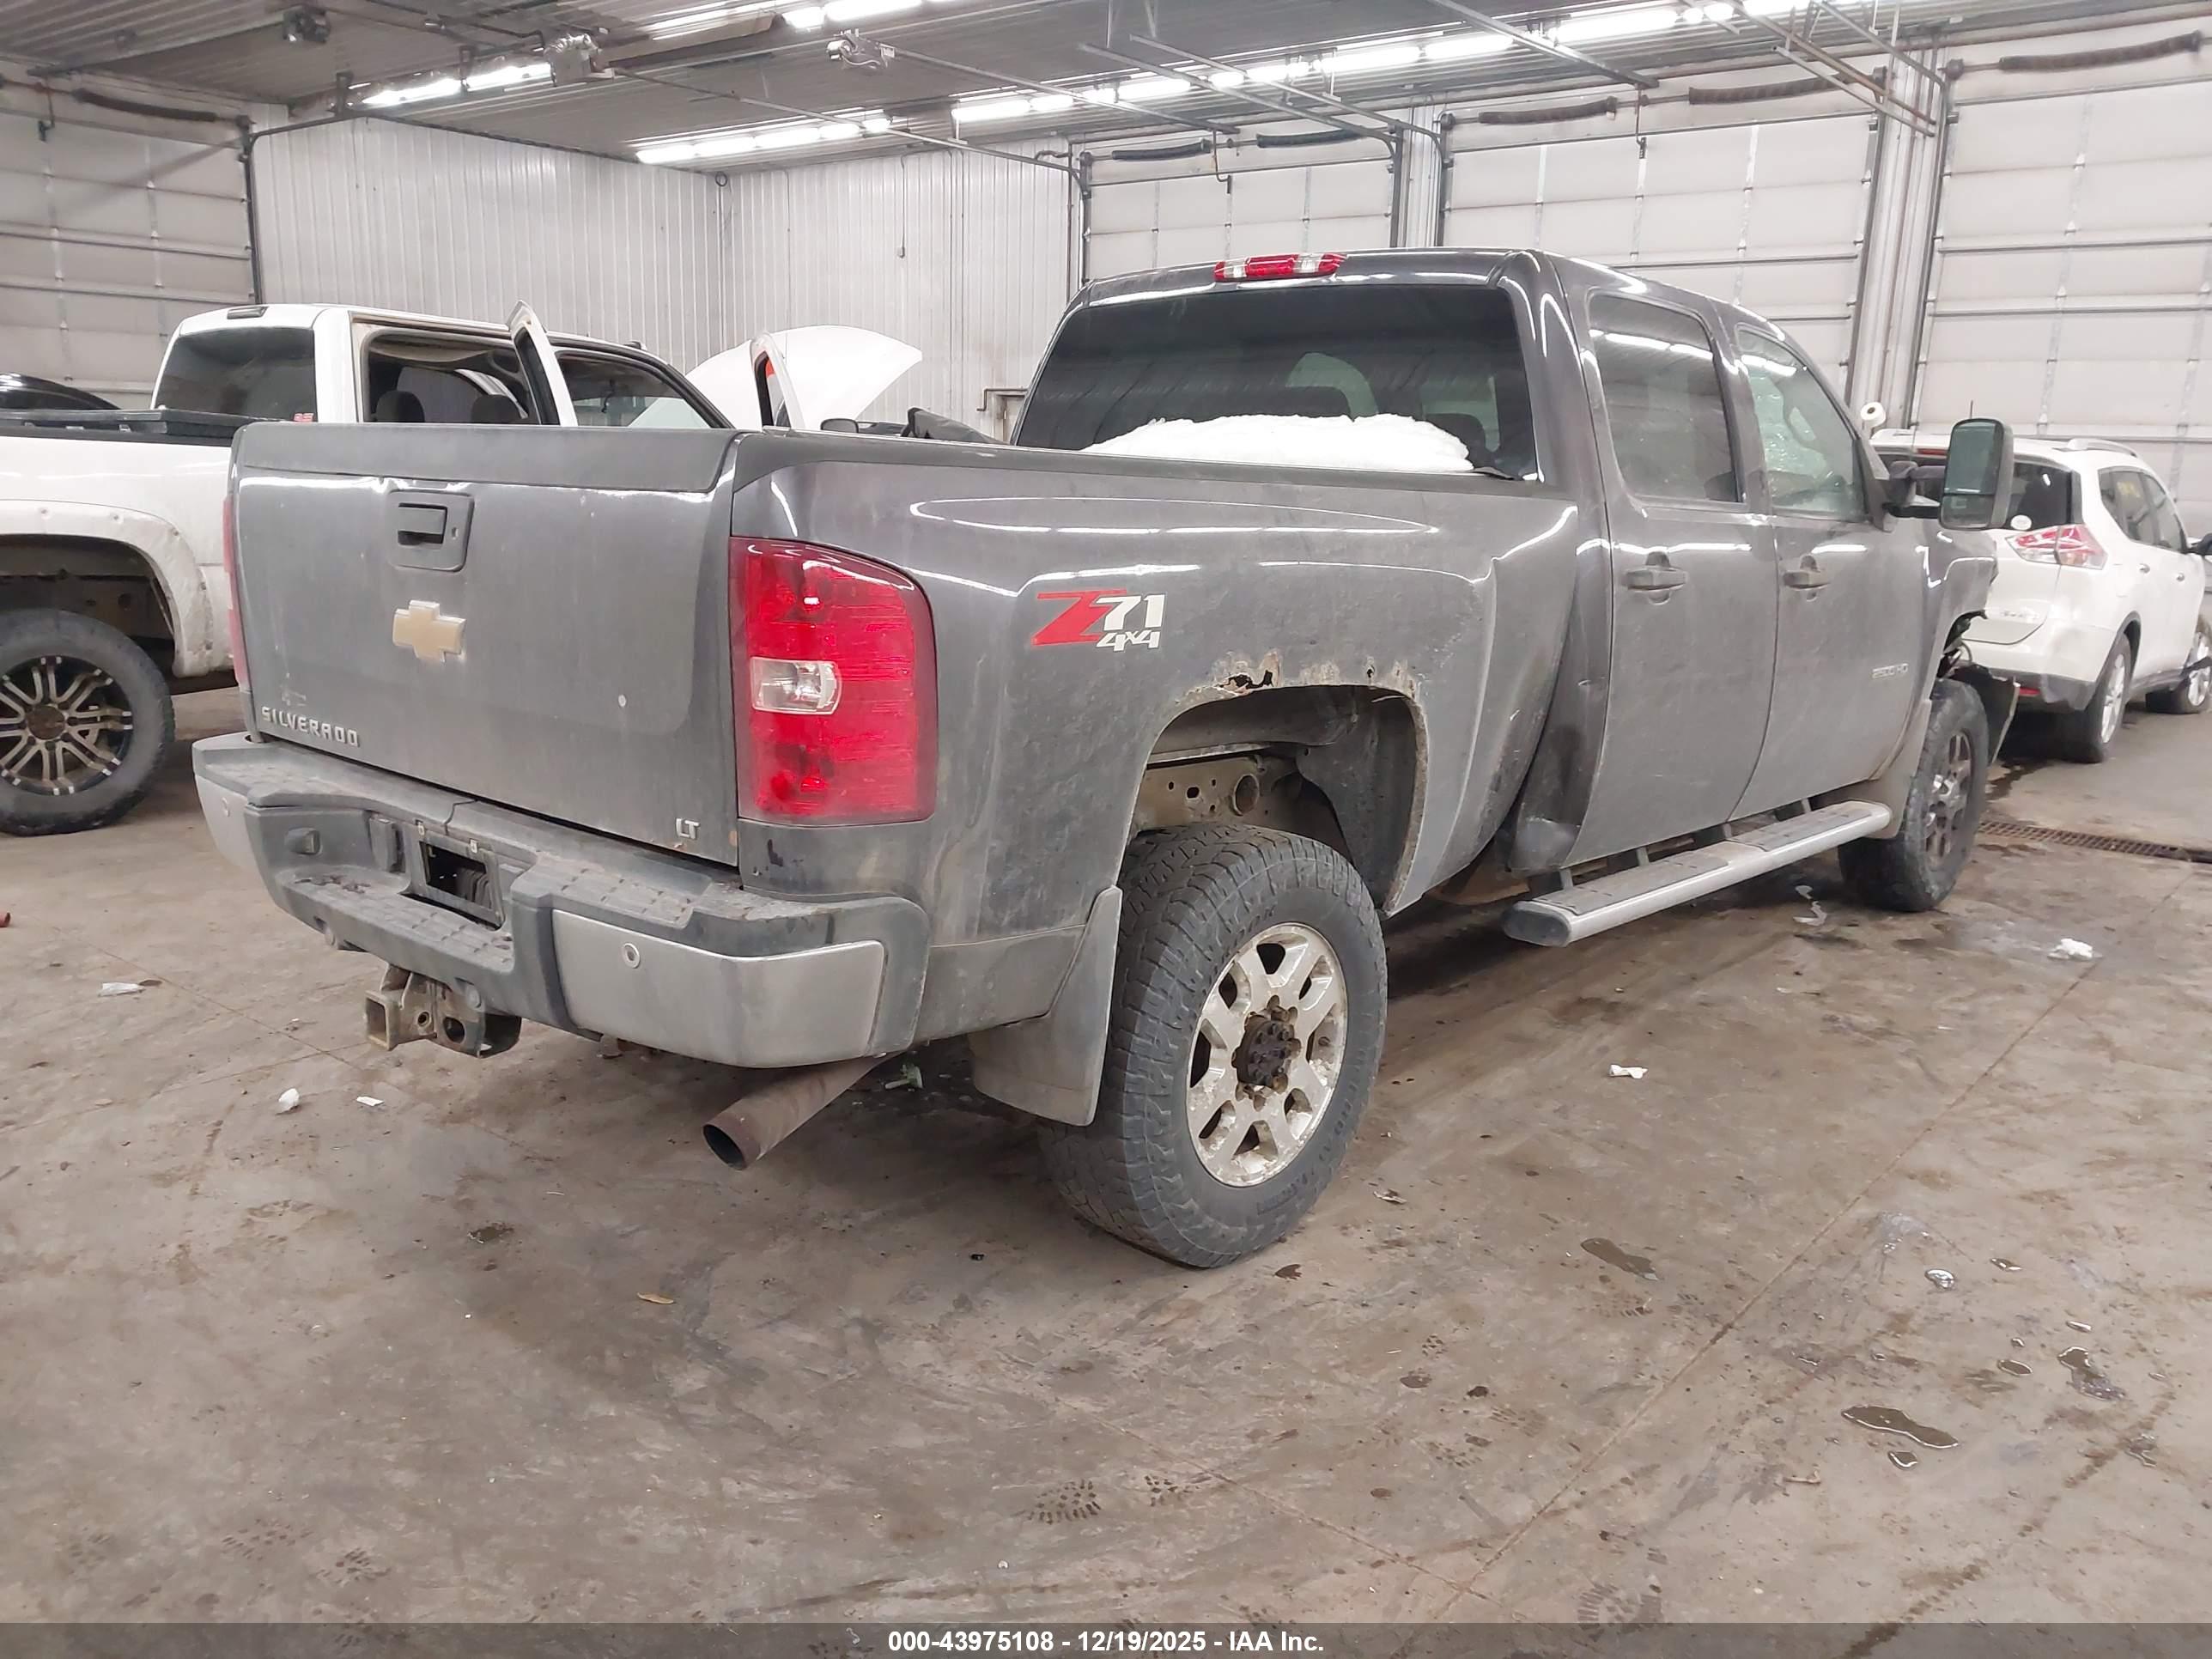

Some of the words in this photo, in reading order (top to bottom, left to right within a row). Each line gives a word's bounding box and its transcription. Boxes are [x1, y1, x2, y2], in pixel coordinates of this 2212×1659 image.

[1032, 588, 1165, 647] Z71
[261, 706, 359, 747] SILVERADO
[676, 817, 699, 840] LT
